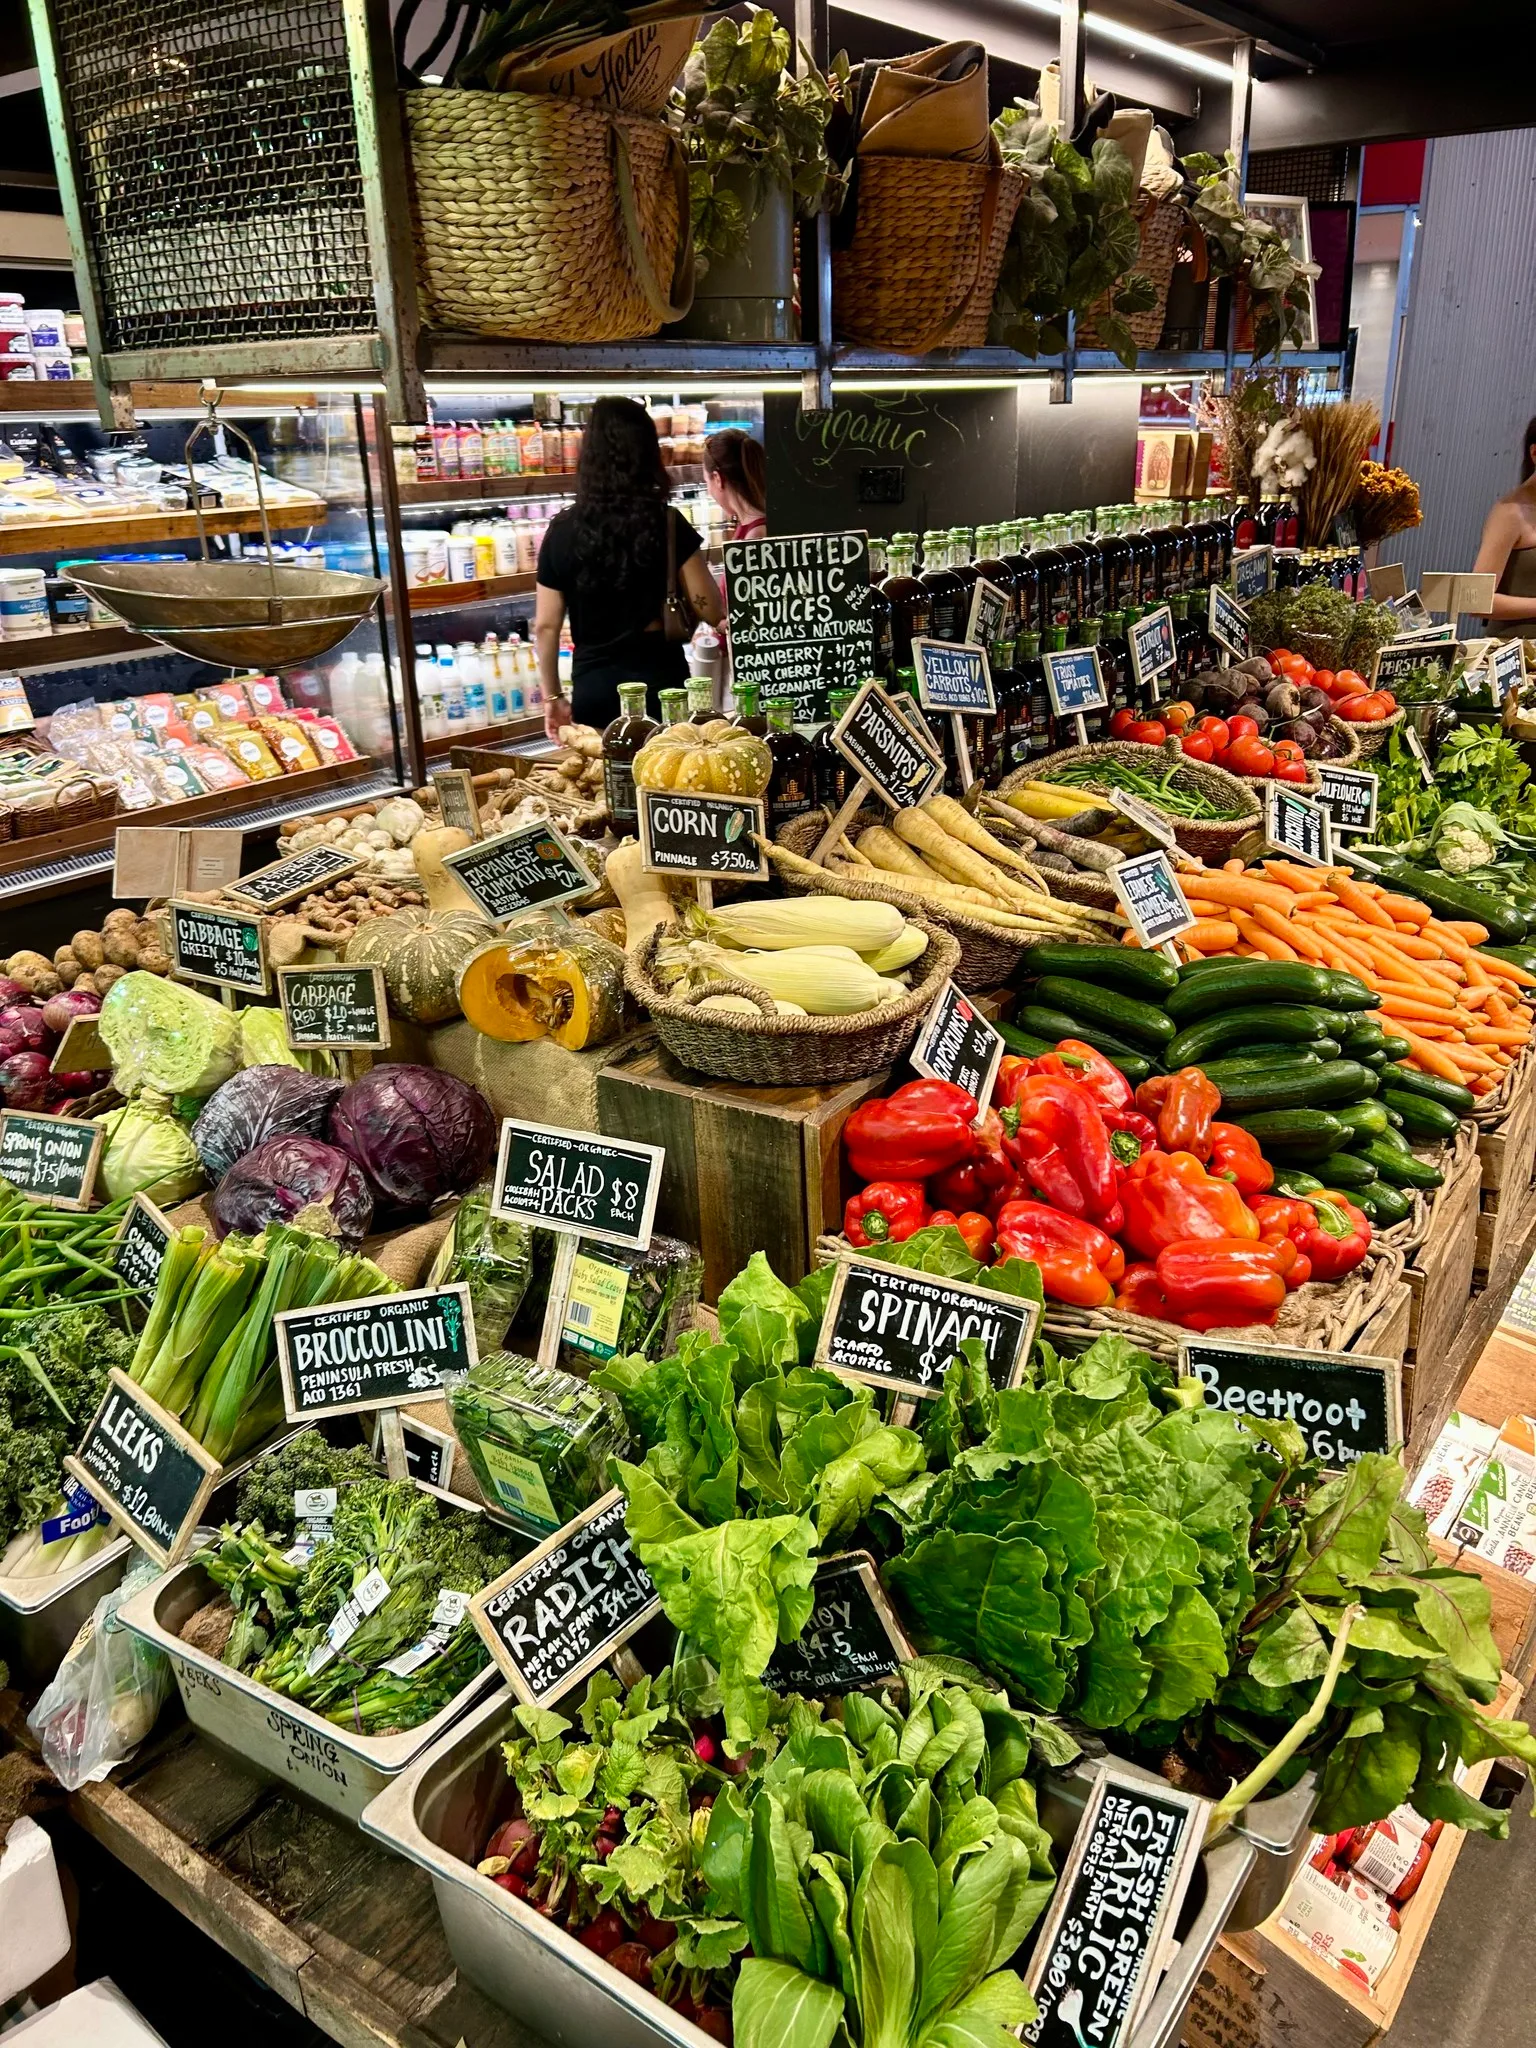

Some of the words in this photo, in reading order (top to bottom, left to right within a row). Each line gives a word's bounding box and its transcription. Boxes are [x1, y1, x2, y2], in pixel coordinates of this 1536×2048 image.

[725, 535, 864, 575] CERTIFIED
[734, 568, 846, 602] ORGANIC
[752, 595, 833, 626] JUICES
[732, 622, 806, 645] GEORGIA'S
[813, 618, 874, 639] NATURALS
[735, 645, 824, 669] CRANBERRY
[835, 639, 873, 657] $17.99
[736, 668, 772, 683] SOUR
[774, 662, 823, 681] CHERRY
[834, 656, 872, 673] $12.99
[923, 655, 969, 677] YELLOW
[925, 673, 971, 694] CARROTS
[881, 704, 907, 737] CERTIFIED
[854, 700, 918, 779] PARSNIPS
[863, 755, 876, 770] ACO
[671, 798, 701, 807] CERTIFIED
[888, 770, 917, 808] $12/kg
[654, 806, 718, 839] CORN
[1284, 805, 1305, 852] ZUCCHINI
[266, 853, 345, 894] FRESH
[464, 845, 540, 887] JAPANESE
[654, 851, 698, 867] PINNACLE
[475, 863, 547, 903] PUMPKIN
[178, 918, 244, 951] CABBAGE
[180, 943, 218, 960] GREEN
[214, 962, 228, 976] $5
[225, 949, 244, 967] $10
[290, 983, 356, 1007] CABBAGE
[292, 1009, 317, 1026] RED
[324, 1006, 347, 1020] $10
[356, 1022, 377, 1033] HALF
[932, 1008, 969, 1082] CAPSICUMS
[3, 1131, 42, 1161] SPRING
[45, 1140, 84, 1159] ONION
[524, 1149, 605, 1198] SALAD
[504, 1184, 541, 1199] COOLIBAH
[540, 1186, 598, 1221] PACKS
[611, 1177, 640, 1211] $8
[610, 1207, 635, 1222] EACH
[871, 1272, 941, 1304] CERTIFIED
[941, 1292, 999, 1316] ORGANIC
[313, 1308, 372, 1328] CERTIFIED
[379, 1299, 430, 1318] ORGANIC
[858, 1289, 1001, 1361] SPINACH
[293, 1315, 448, 1372] BROCCOLINI
[833, 1335, 884, 1358] SCARFO
[300, 1362, 372, 1391] PENINSULA
[373, 1357, 416, 1378] FRESH
[302, 1389, 327, 1407] ACO
[330, 1382, 362, 1403] 1361
[1194, 1363, 1367, 1433] Beetroot
[100, 1394, 165, 1475] LEEKS
[430, 1450, 439, 1482] EACH
[122, 1484, 148, 1522] $12
[144, 1505, 177, 1542] BUNCH
[487, 1548, 569, 1620] CERTIFIED
[571, 1500, 630, 1551] ORGANI
[502, 1537, 633, 1661] RADISH
[523, 1631, 569, 1679] MERAKI
[568, 1604, 600, 1638] FARM
[848, 1651, 879, 1666] EACH
[531, 1665, 558, 1691] OFC
[555, 1629, 591, 1669] 0875
[857, 1660, 898, 1676] BUNCH
[177, 1659, 222, 1697] LEEKS
[266, 1710, 341, 1766] SPRING
[289, 1744, 348, 1788] ONION
[1081, 1832, 1108, 1878] 0875
[1126, 1810, 1176, 1922] FRESH
[1077, 1804, 1155, 1981] GARLIC
[1080, 1869, 1108, 1921] FARM
[1145, 1855, 1175, 1938] CERTIFIED
[1086, 1926, 1140, 2042] GREEN
[1115, 1946, 1148, 2020] ORGANIC
